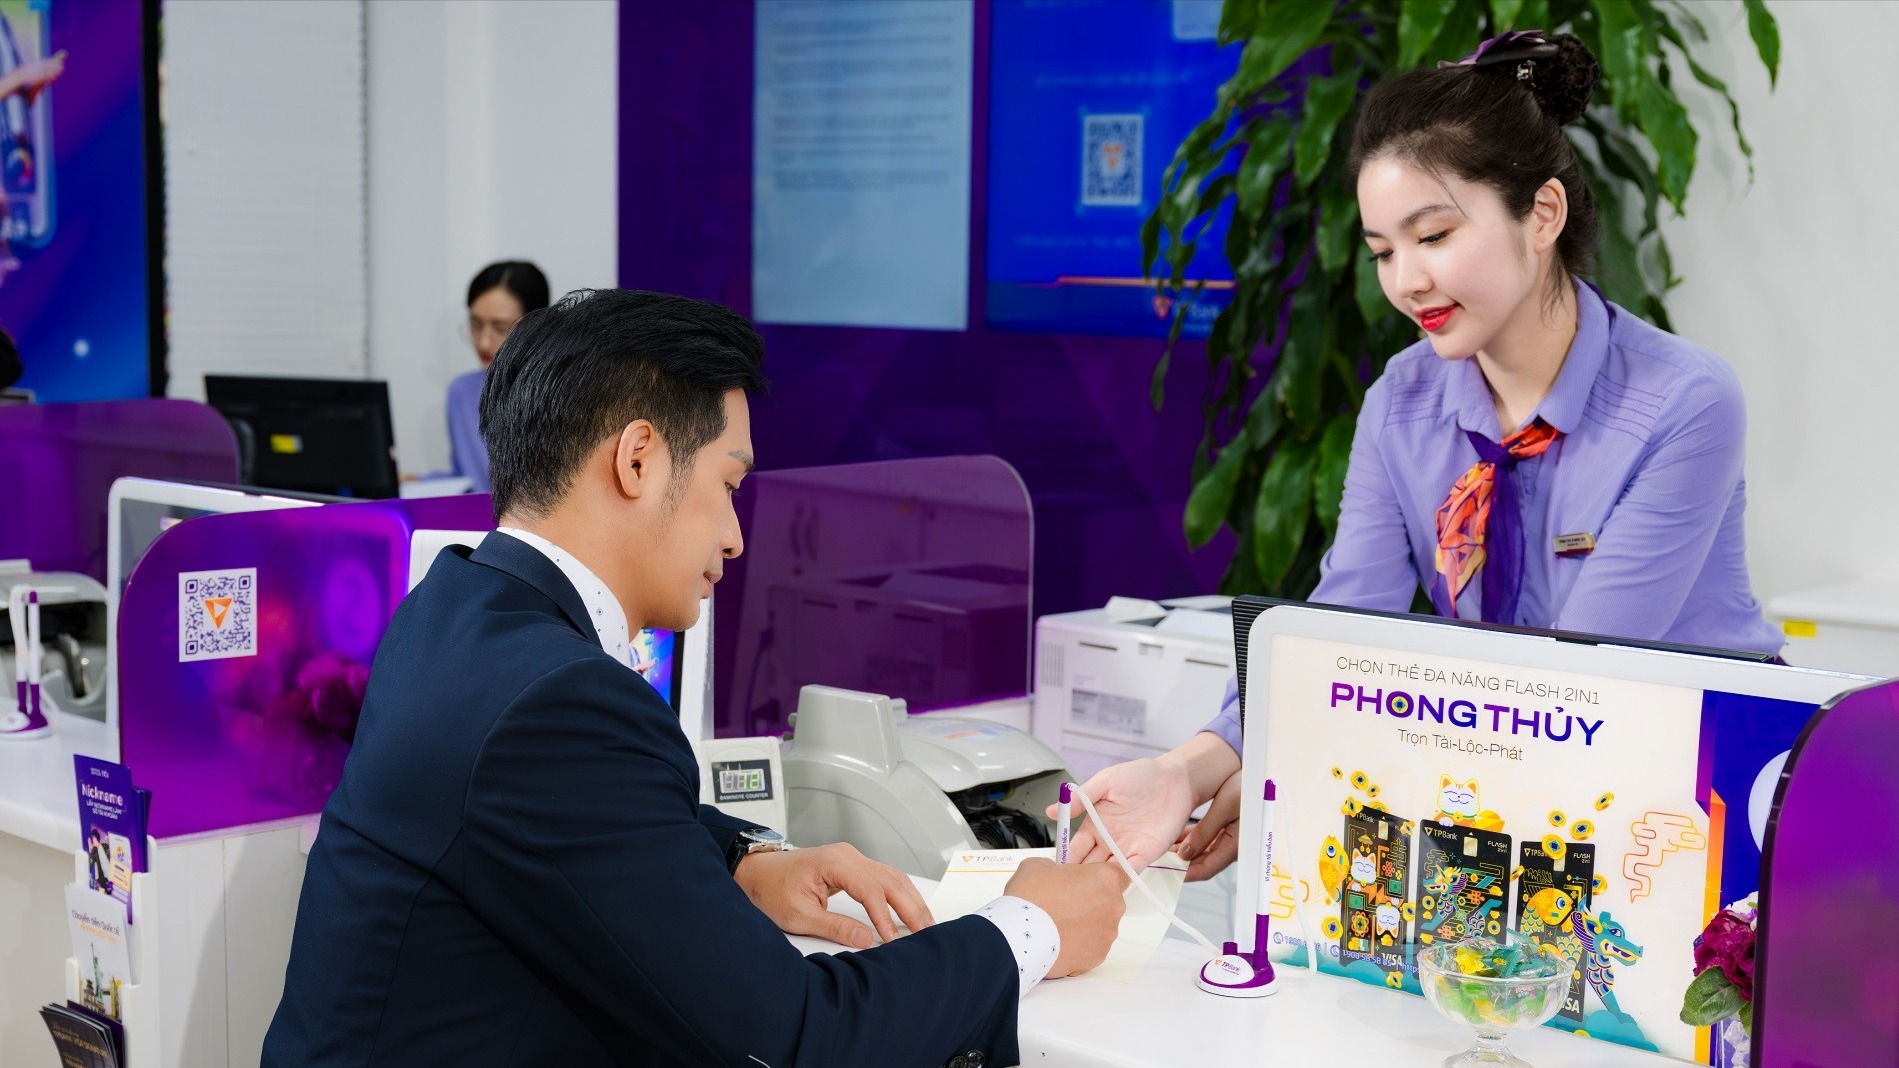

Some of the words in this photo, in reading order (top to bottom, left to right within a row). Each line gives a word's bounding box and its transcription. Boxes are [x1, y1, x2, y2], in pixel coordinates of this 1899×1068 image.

[1336, 655, 1384, 675] CHỌN
[1388, 662, 1420, 681] THẺ
[1424, 668, 1447, 684] ĐA
[1450, 669, 1500, 692] NĂNG
[1504, 679, 1560, 700] FLASH
[1564, 687, 1600, 706] 2IN1
[1330, 682, 1478, 730] PHONG
[1483, 703, 1605, 746] THỦY
[1397, 727, 1428, 747] Trọn
[1431, 732, 1524, 761] Tài-Lộc-Phát
[81, 783, 123, 806] Nickname
[719, 793, 745, 801] BANKNOTE
[1434, 829, 1457, 840] TPBank
[1487, 840, 1508, 849] FLASH
[1381, 952, 1403, 966] VISA
[1222, 962, 1241, 972] TPBank
